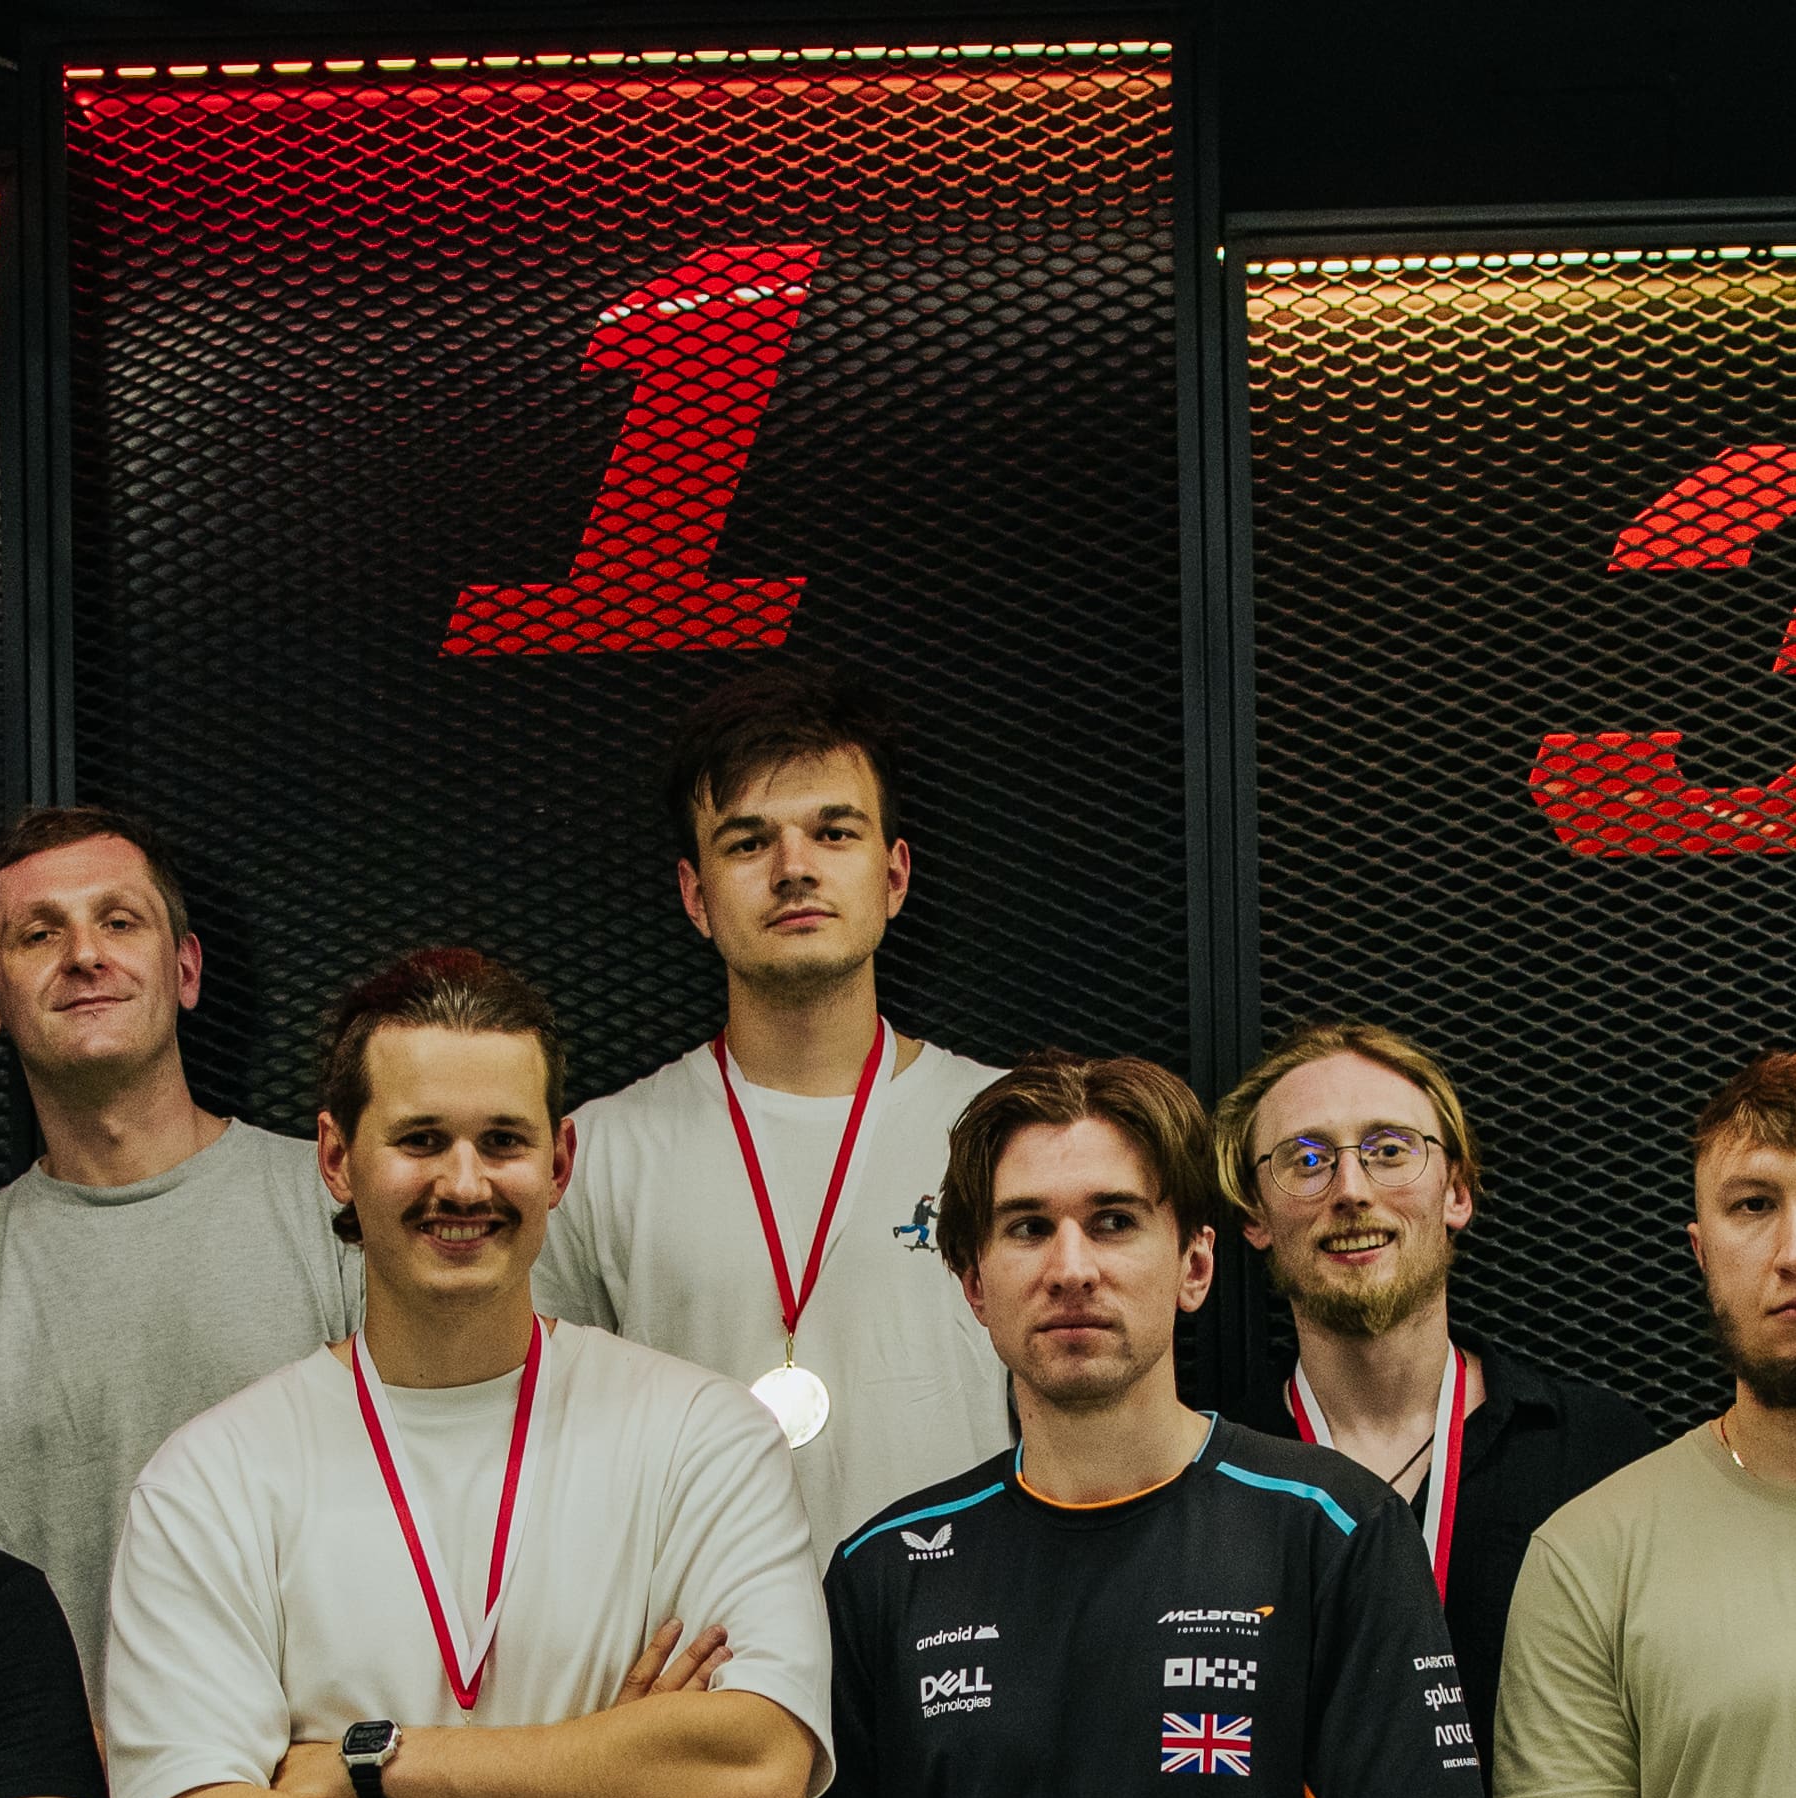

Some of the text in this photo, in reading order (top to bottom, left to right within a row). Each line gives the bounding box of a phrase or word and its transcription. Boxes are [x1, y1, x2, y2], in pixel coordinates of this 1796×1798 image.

[438, 244, 822, 657] 1
[1157, 1608, 1261, 1625] McLaren
[916, 1625, 973, 1651] android
[1177, 1626, 1221, 1634] FORMULA
[1235, 1627, 1260, 1637] TEAM
[920, 1666, 993, 1703] DELL
[1163, 1657, 1258, 1691] OKX
[921, 1696, 991, 1719] Technologies
